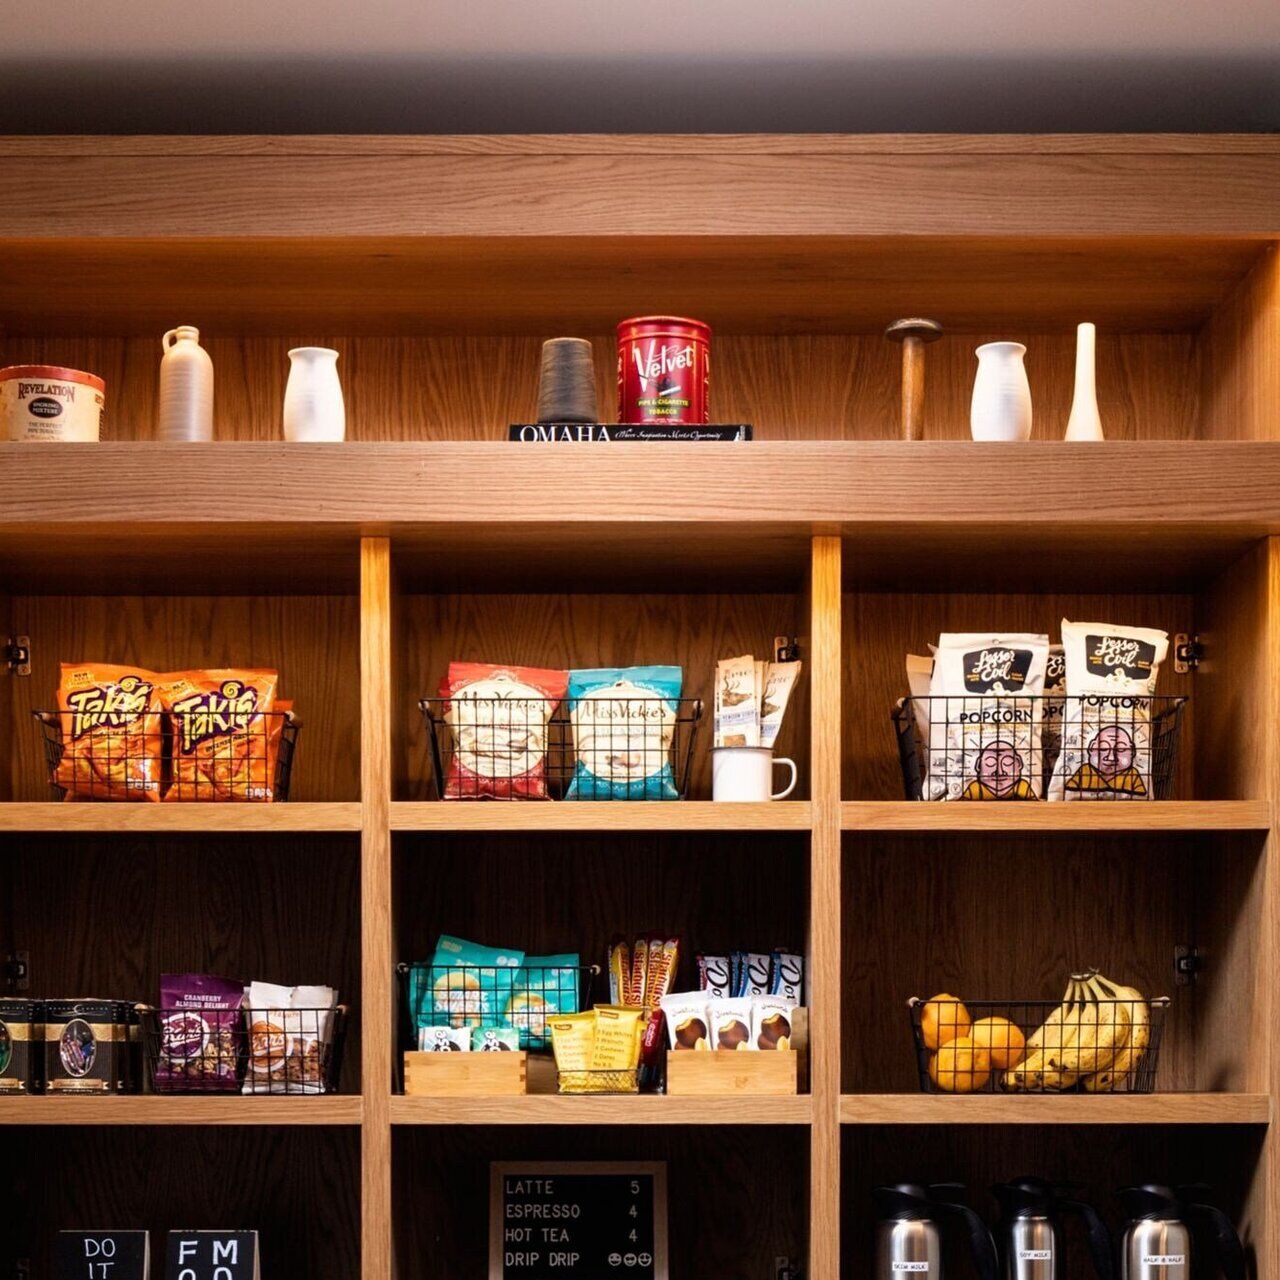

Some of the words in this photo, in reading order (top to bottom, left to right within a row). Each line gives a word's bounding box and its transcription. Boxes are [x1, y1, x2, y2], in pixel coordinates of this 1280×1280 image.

[633, 338, 693, 393] Velvet
[17, 382, 75, 403] REVELATION
[519, 425, 611, 442] OMAHA
[1094, 635, 1140, 657] Lesser
[971, 650, 1016, 674] Lesser
[1104, 650, 1137, 668] Evil
[980, 661, 1012, 682] Evil
[580, 702, 618, 720] Miss
[618, 701, 668, 720] Vickie's
[1078, 694, 1150, 710] POPCORN
[960, 709, 1033, 724] POPCORN
[651, 953, 673, 1007] Starburst
[175, 1000, 202, 1008] ALMOND
[184, 994, 222, 1002] CRANBERRY
[505, 1180, 554, 1195] LATTE
[630, 1180, 640, 1195] 5
[505, 1204, 581, 1219] ESPRESSO
[628, 1204, 638, 1219] 4
[505, 1228, 532, 1243] HOT
[541, 1228, 570, 1243] TEA
[628, 1228, 638, 1243] 4
[84, 1238, 116, 1258] DO
[505, 1252, 540, 1267] DRIP
[548, 1252, 580, 1267] DRIP
[89, 1262, 115, 1280] IT
